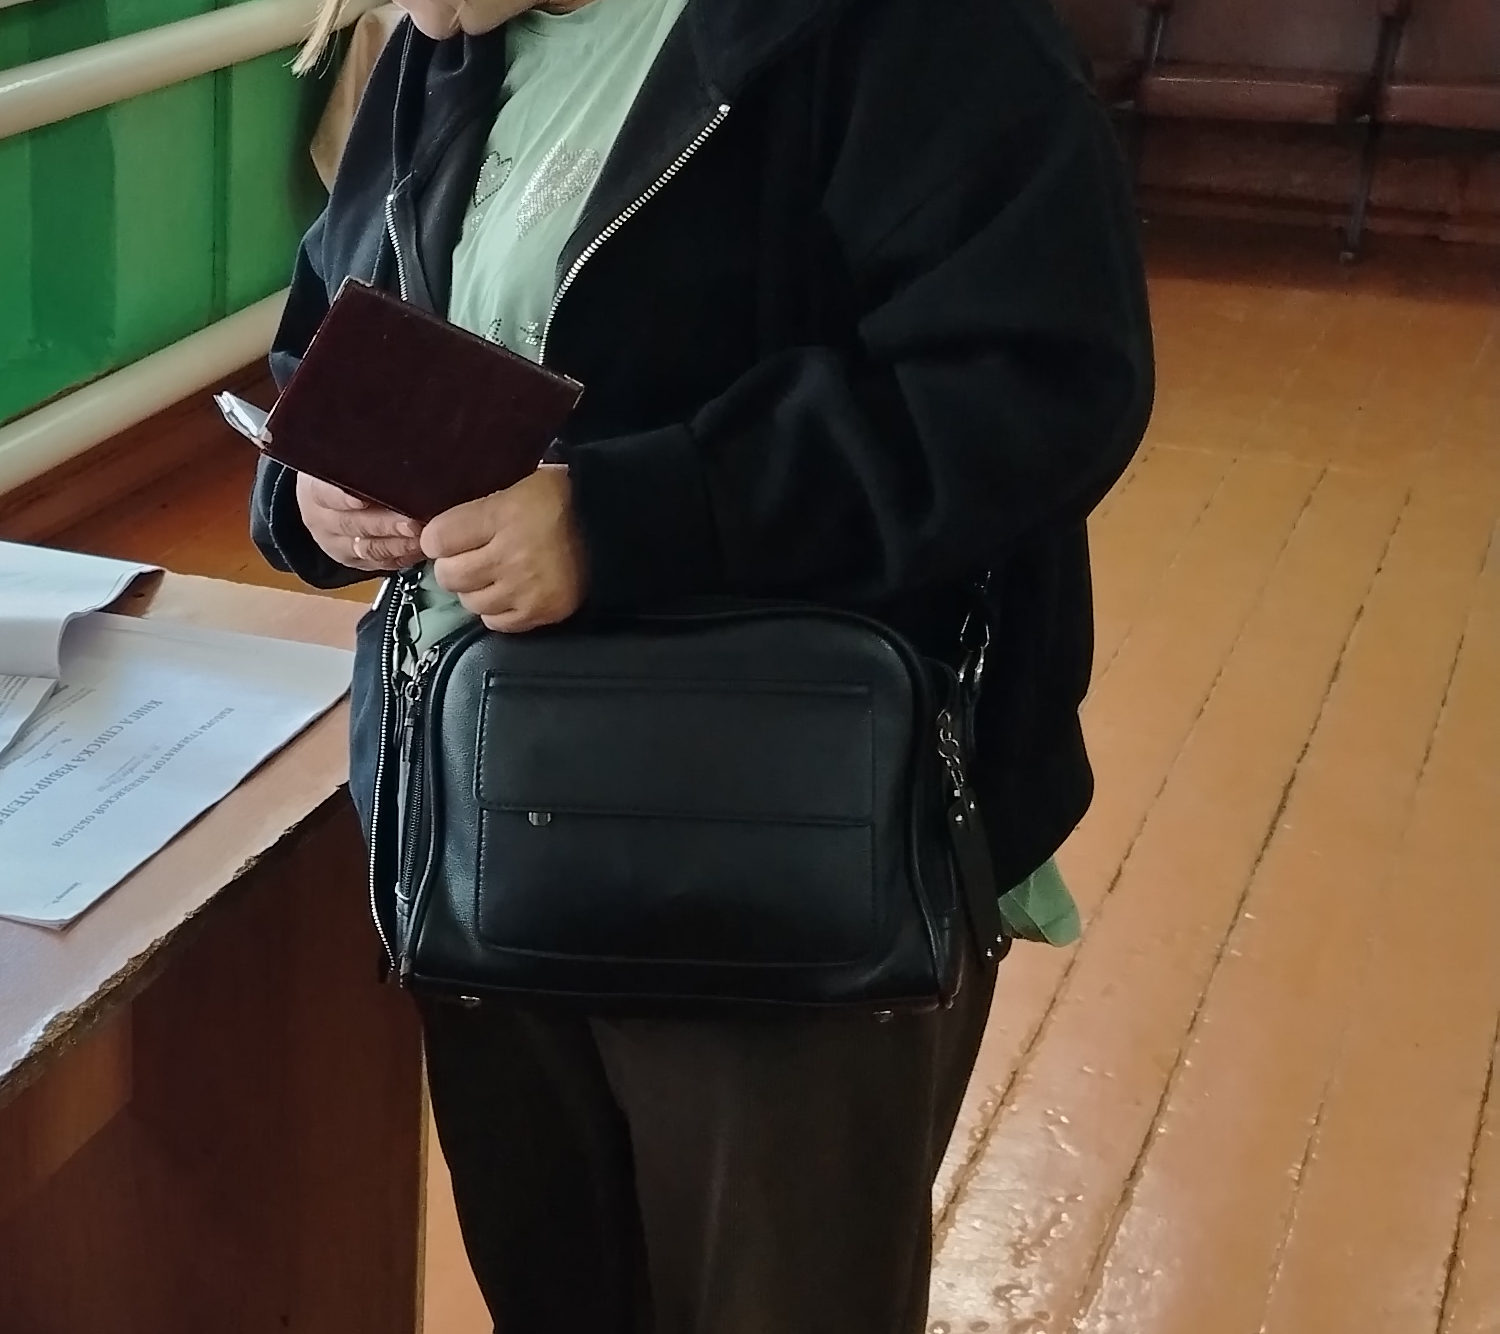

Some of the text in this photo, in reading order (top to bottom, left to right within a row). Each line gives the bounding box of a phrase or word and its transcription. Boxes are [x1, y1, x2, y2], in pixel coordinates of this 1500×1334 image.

[119, 699, 163, 725] КНИГА
[70, 725, 123, 762] СПИСКА
[145, 730, 202, 773] ГУБЕРНАТОРА
[51, 815, 95, 847] ОБЛАСТИ
